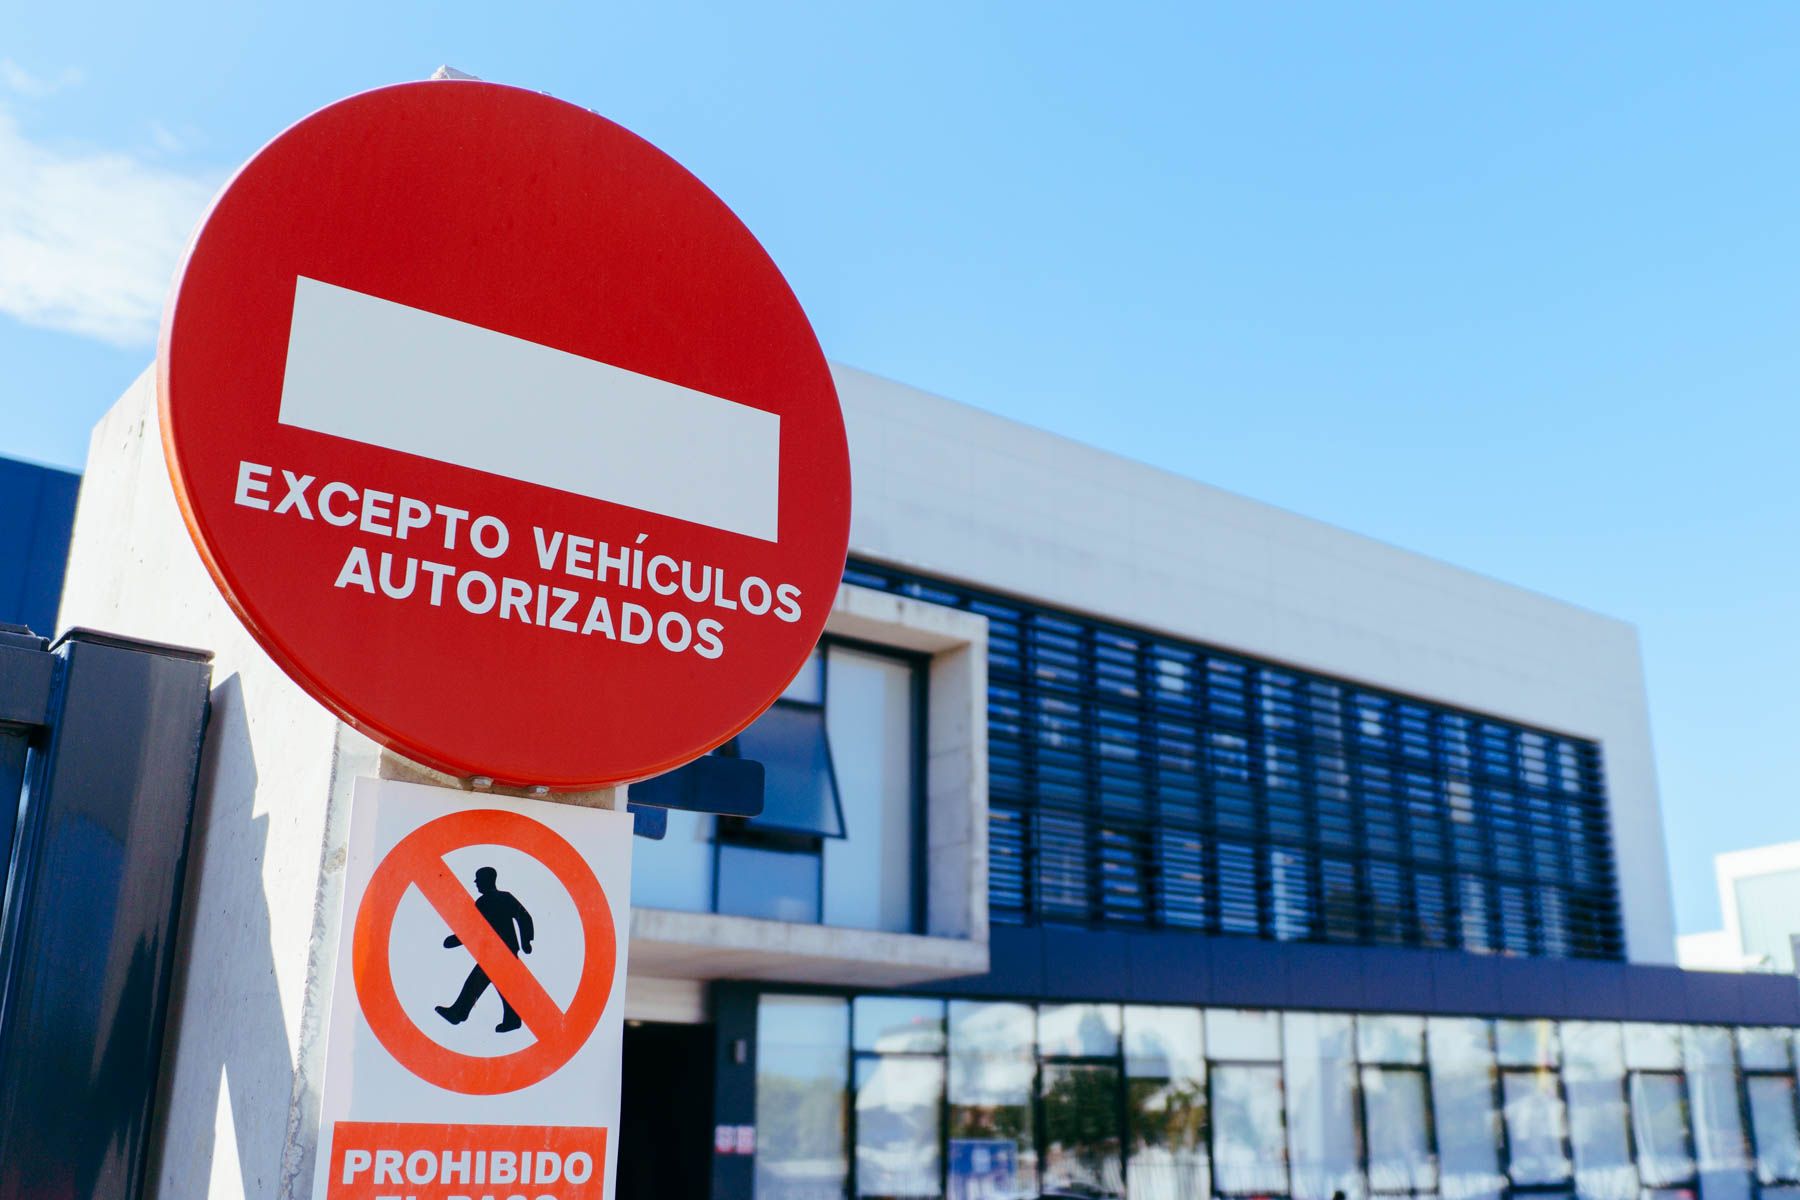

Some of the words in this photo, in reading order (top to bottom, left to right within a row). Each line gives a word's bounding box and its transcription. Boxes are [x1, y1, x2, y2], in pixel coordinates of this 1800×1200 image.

[234, 460, 510, 559] EXCEPTO
[532, 526, 802, 623] VEHÍCULOS
[333, 546, 725, 660] AUTORIZADOS
[341, 1148, 594, 1186] PROHIBIDO
